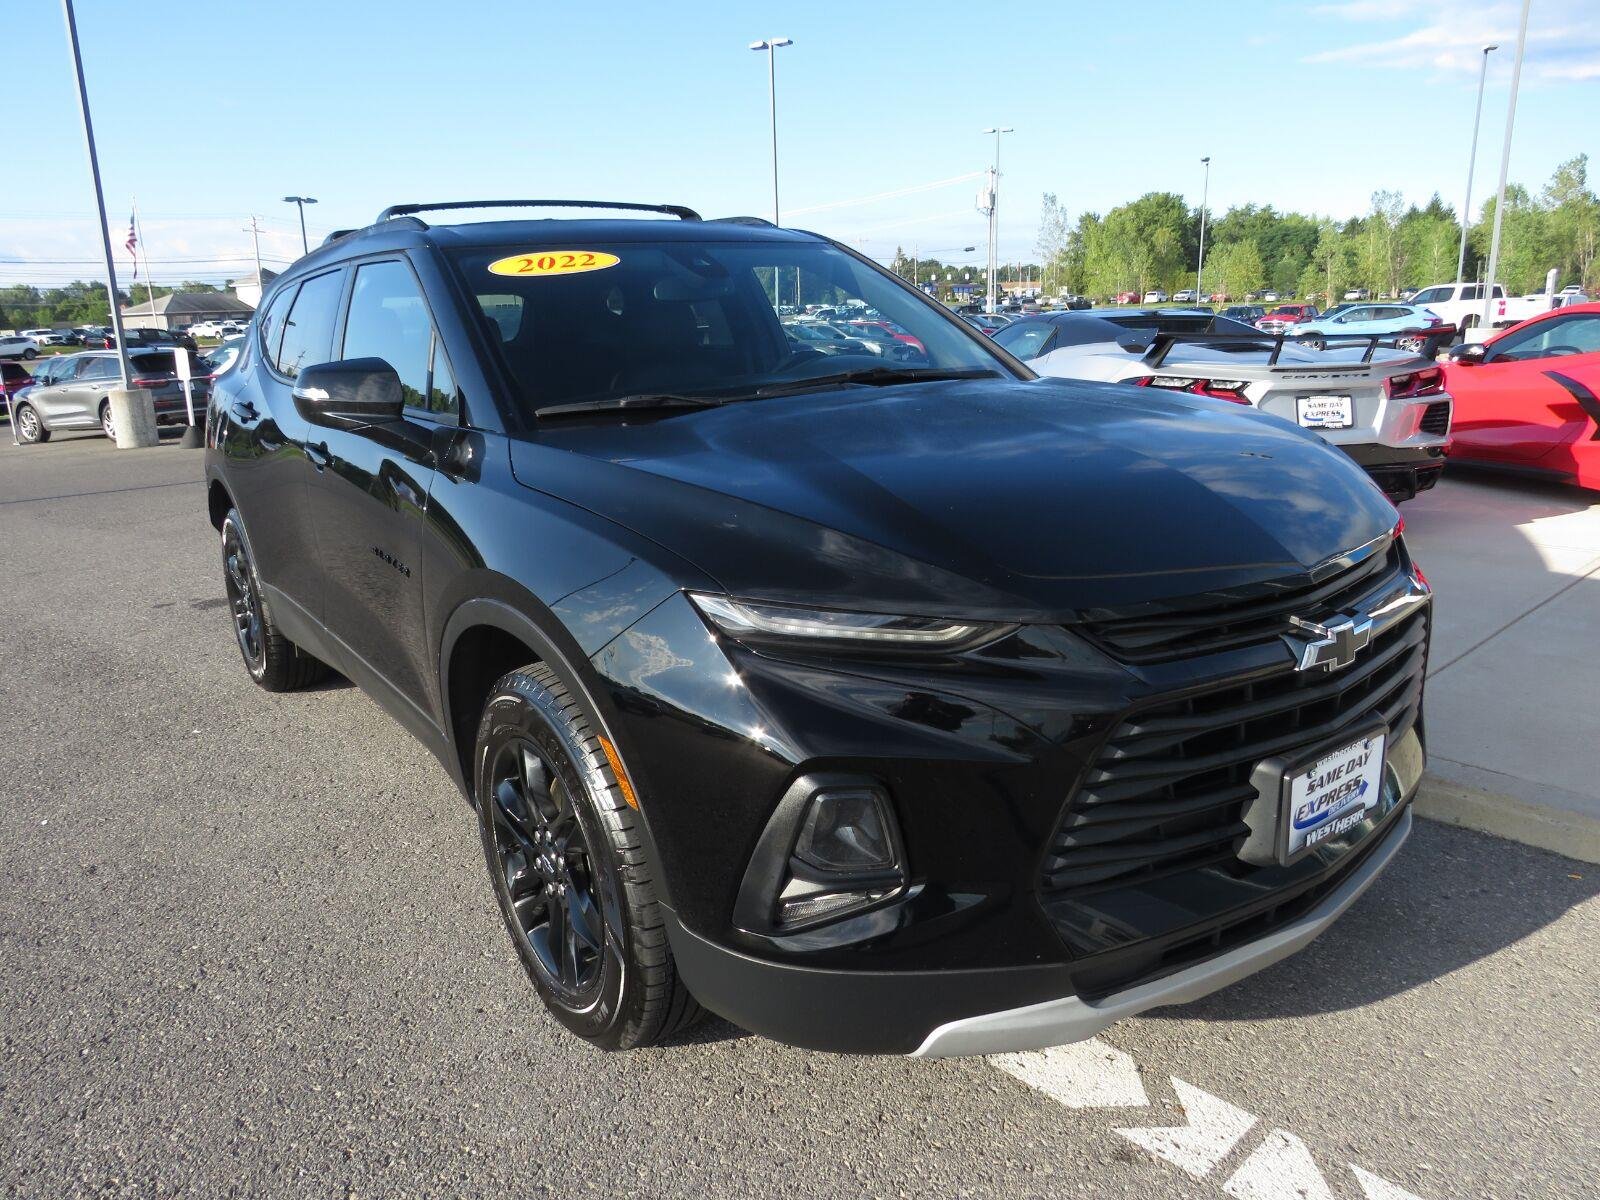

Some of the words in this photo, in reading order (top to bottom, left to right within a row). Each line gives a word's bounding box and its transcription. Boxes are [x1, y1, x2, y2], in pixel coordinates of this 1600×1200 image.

[517, 254, 596, 272] 2022
[1305, 763, 1346, 797] SAME
[1345, 749, 1373, 775] DAY
[1297, 774, 1363, 820] EXPRESS
